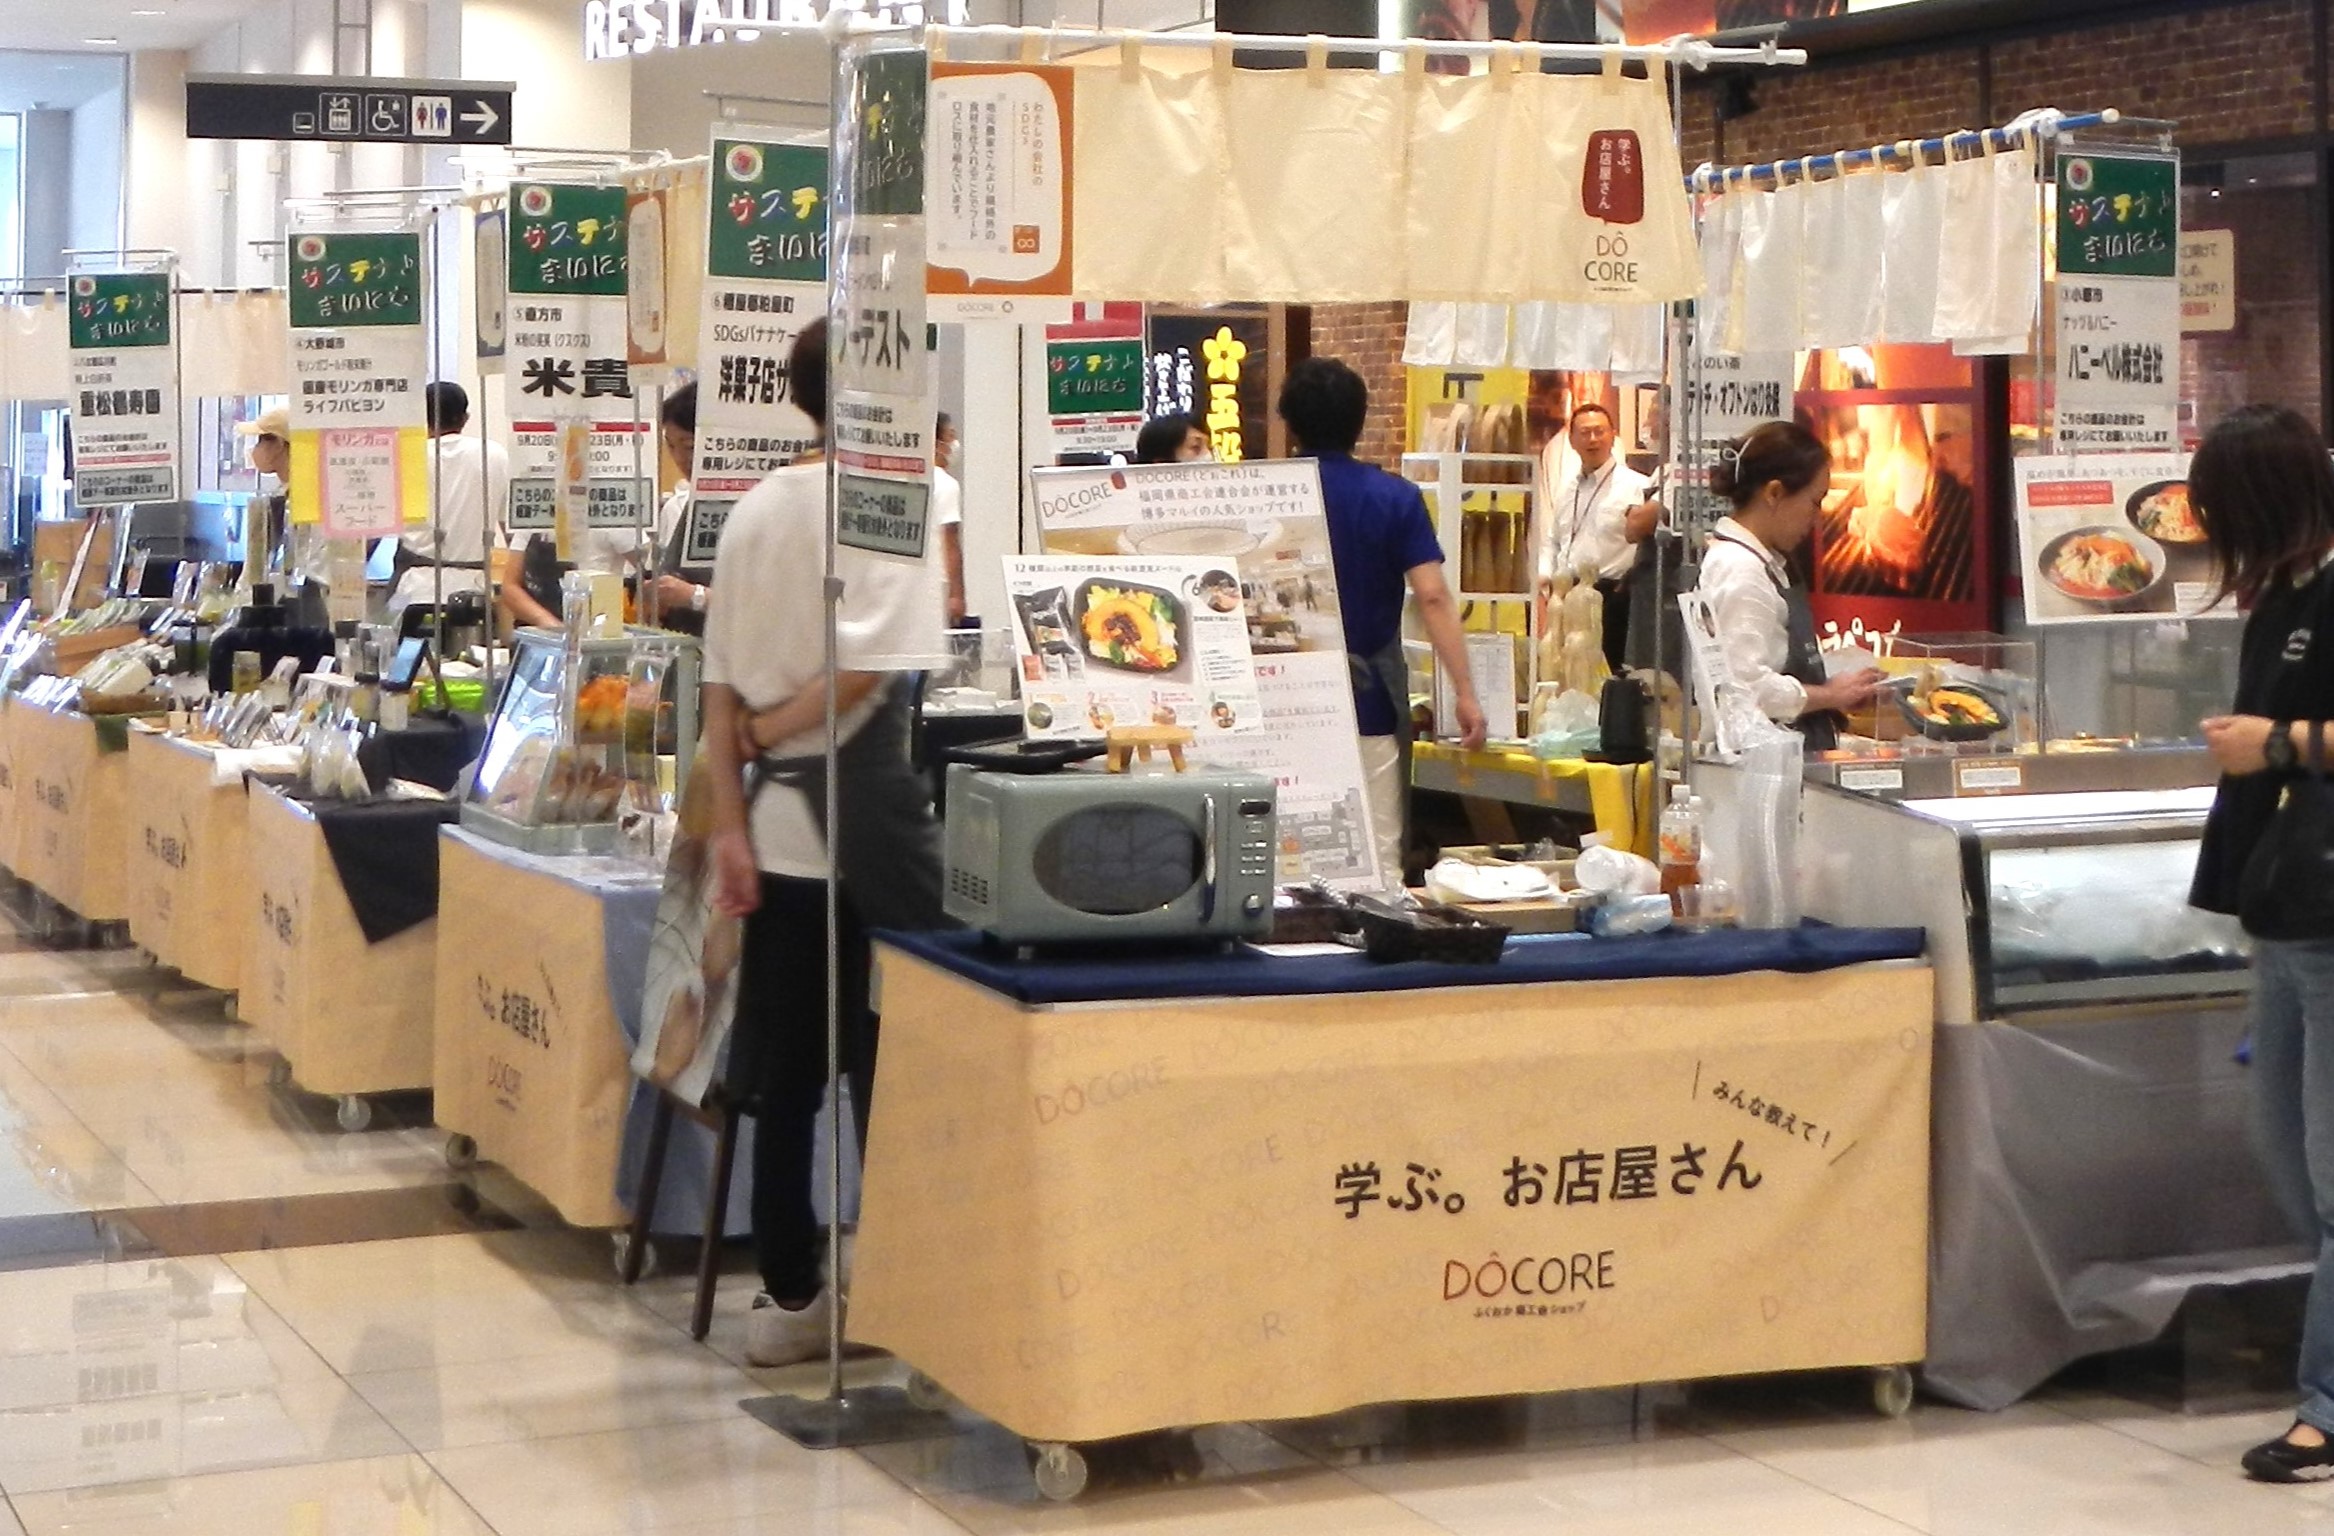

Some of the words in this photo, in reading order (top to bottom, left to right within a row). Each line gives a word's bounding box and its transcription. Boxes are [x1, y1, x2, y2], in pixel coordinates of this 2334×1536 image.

[1599, 138, 1613, 209] お店屋さん
[1596, 231, 1628, 257] DÔ
[1584, 260, 1638, 283] CORE
[718, 355, 796, 404] 洋菓子店サ
[1712, 1080, 1831, 1148] みんな教えて!
[1334, 1139, 1763, 1219] 学ぶ。お店屋さん
[1443, 1250, 1615, 1301] DÔCORE
